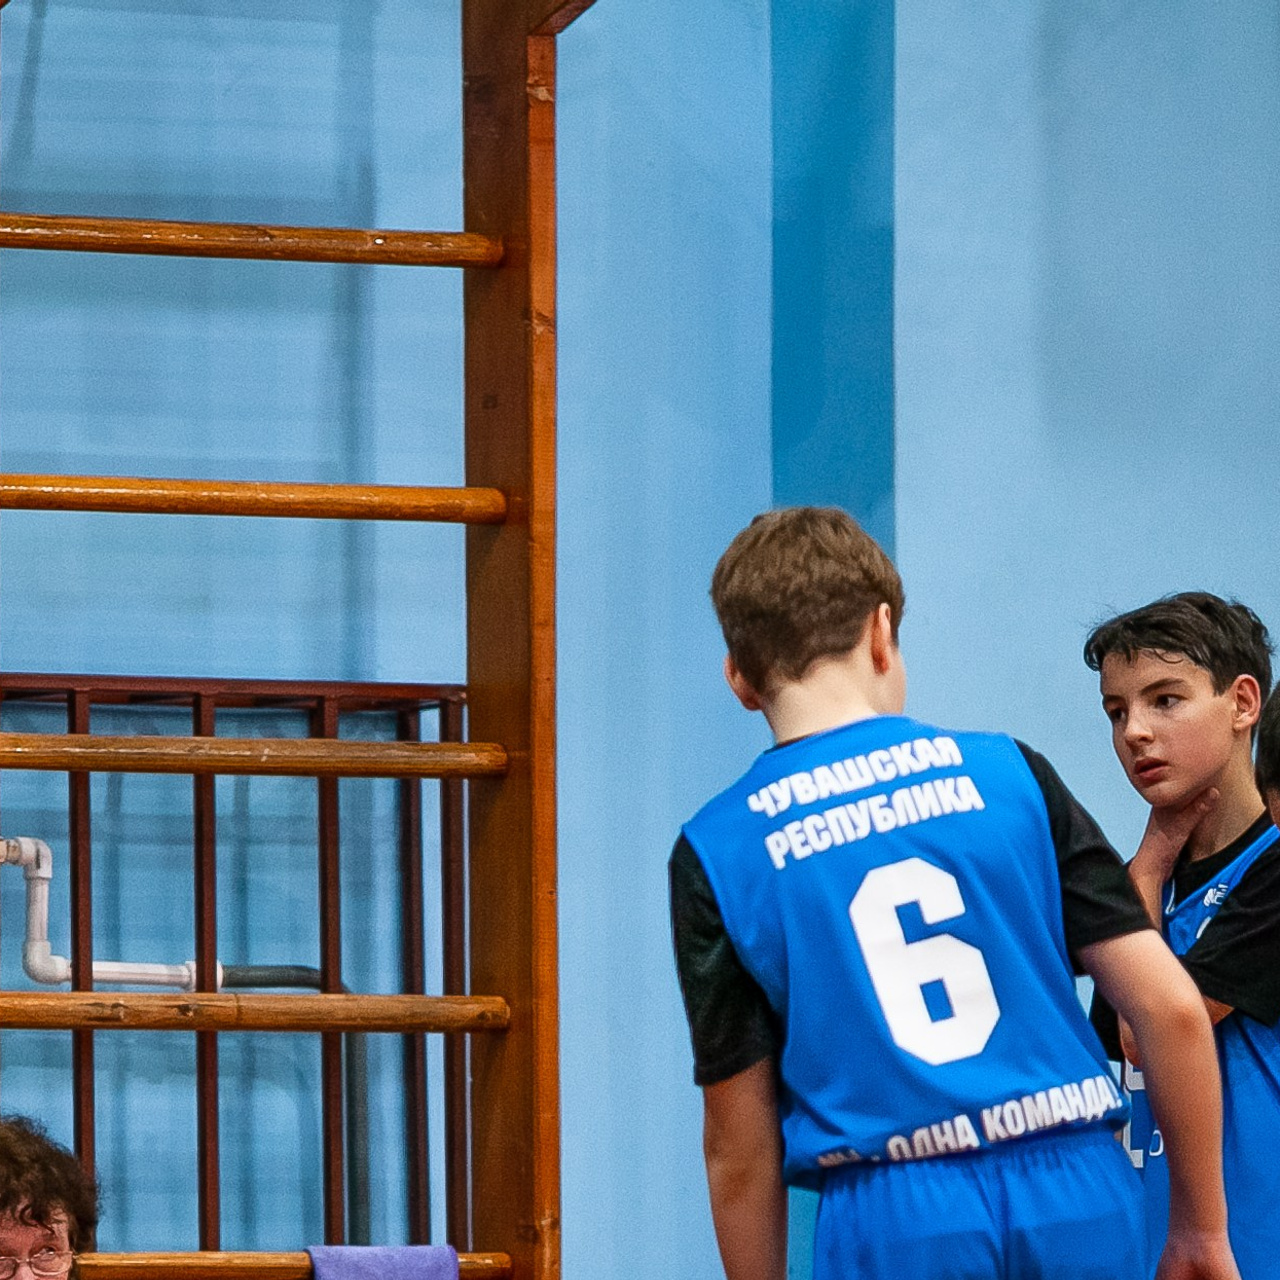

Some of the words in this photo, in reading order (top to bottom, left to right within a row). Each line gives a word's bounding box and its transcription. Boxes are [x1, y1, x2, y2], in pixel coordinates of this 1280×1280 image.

[747, 735, 964, 819] ЧУВАШСКАЯ
[763, 775, 985, 870] РЕСПУБЛИКА
[848, 856, 1002, 1067] 6
